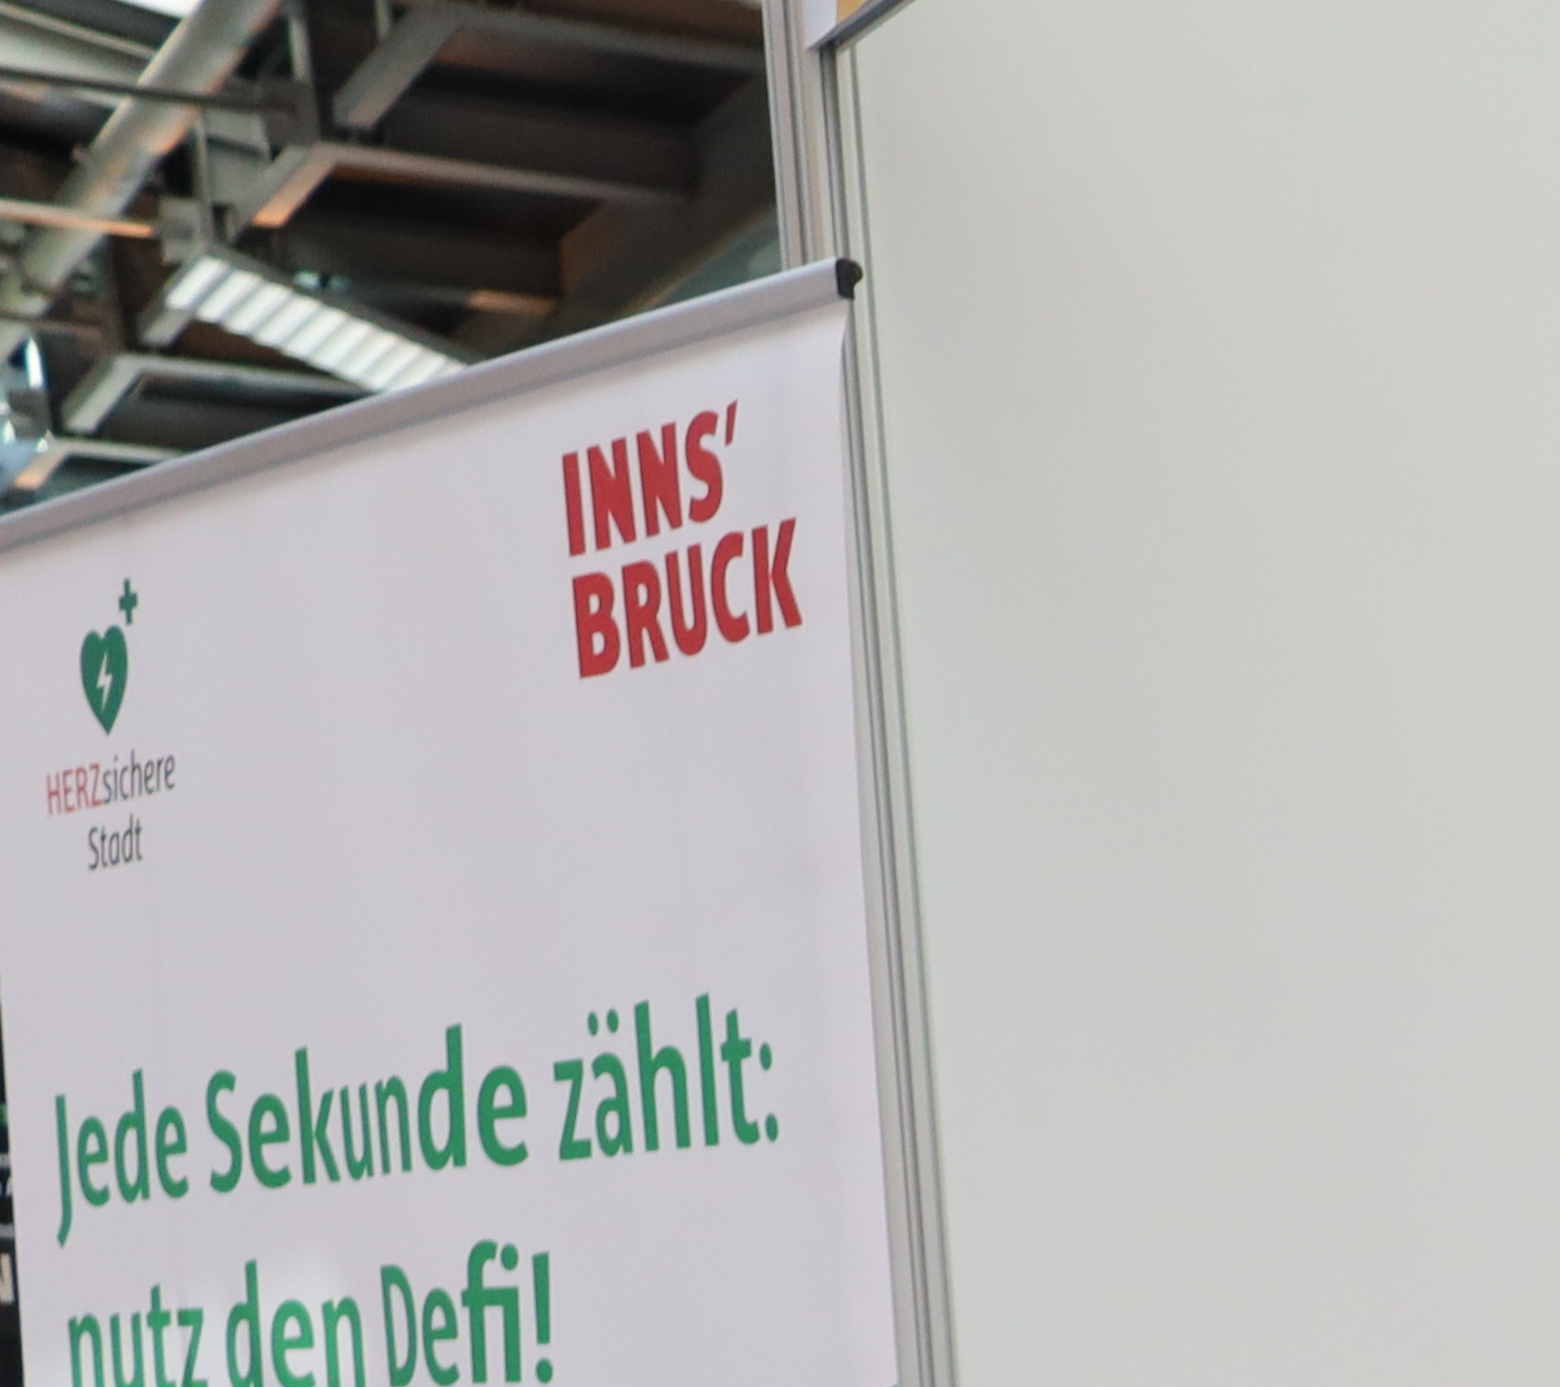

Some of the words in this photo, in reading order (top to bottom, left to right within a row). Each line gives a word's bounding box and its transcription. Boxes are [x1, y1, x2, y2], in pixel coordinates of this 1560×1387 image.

[569, 517, 803, 679] BRUCK
[46, 748, 175, 816] HERZsichere
[88, 813, 144, 871] Stadt
[56, 1069, 189, 1246] Jede
[206, 1024, 528, 1193] Sekunde
[553, 992, 780, 1162] zählt:
[381, 1239, 555, 1387] Defi!
